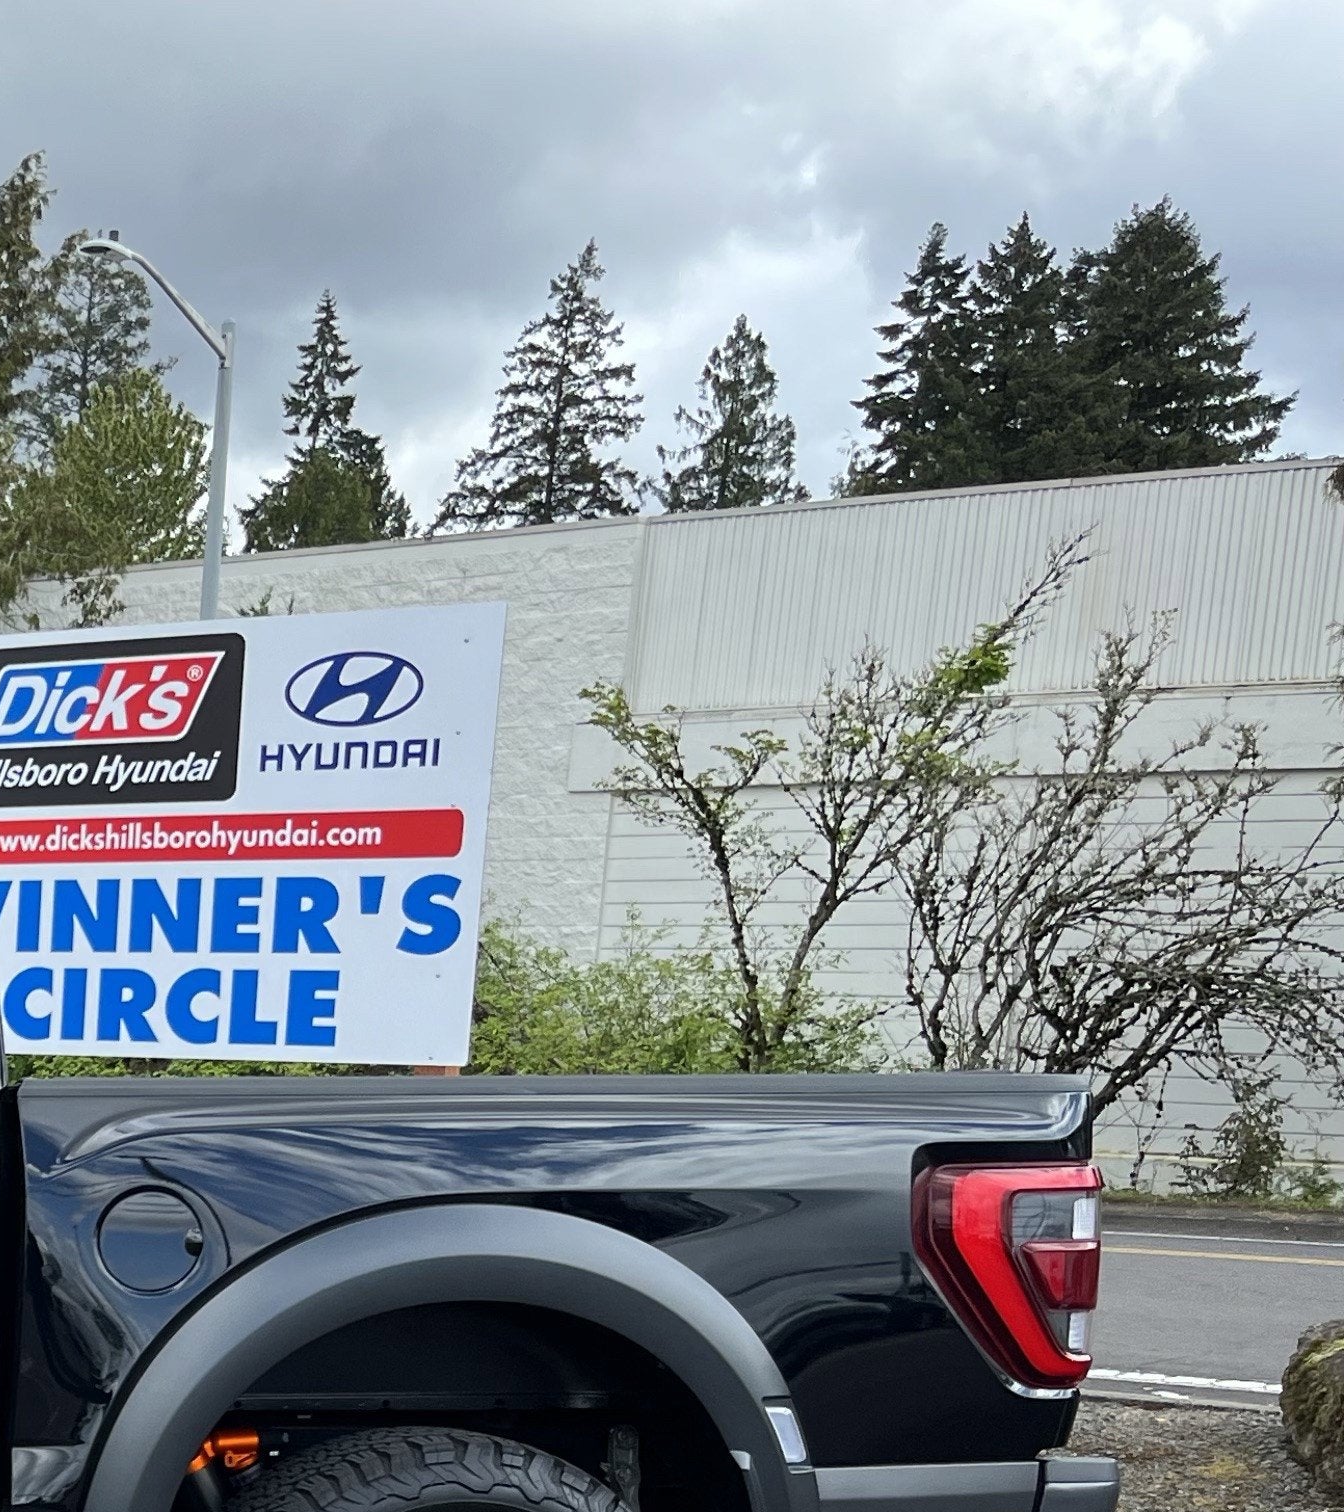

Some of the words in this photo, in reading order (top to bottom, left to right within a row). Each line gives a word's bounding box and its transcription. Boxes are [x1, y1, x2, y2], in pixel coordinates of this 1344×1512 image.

[92, 750, 222, 793] Hyundai
[259, 738, 441, 773] HYUNDAI
[3, 965, 341, 1047] CIRCLE
